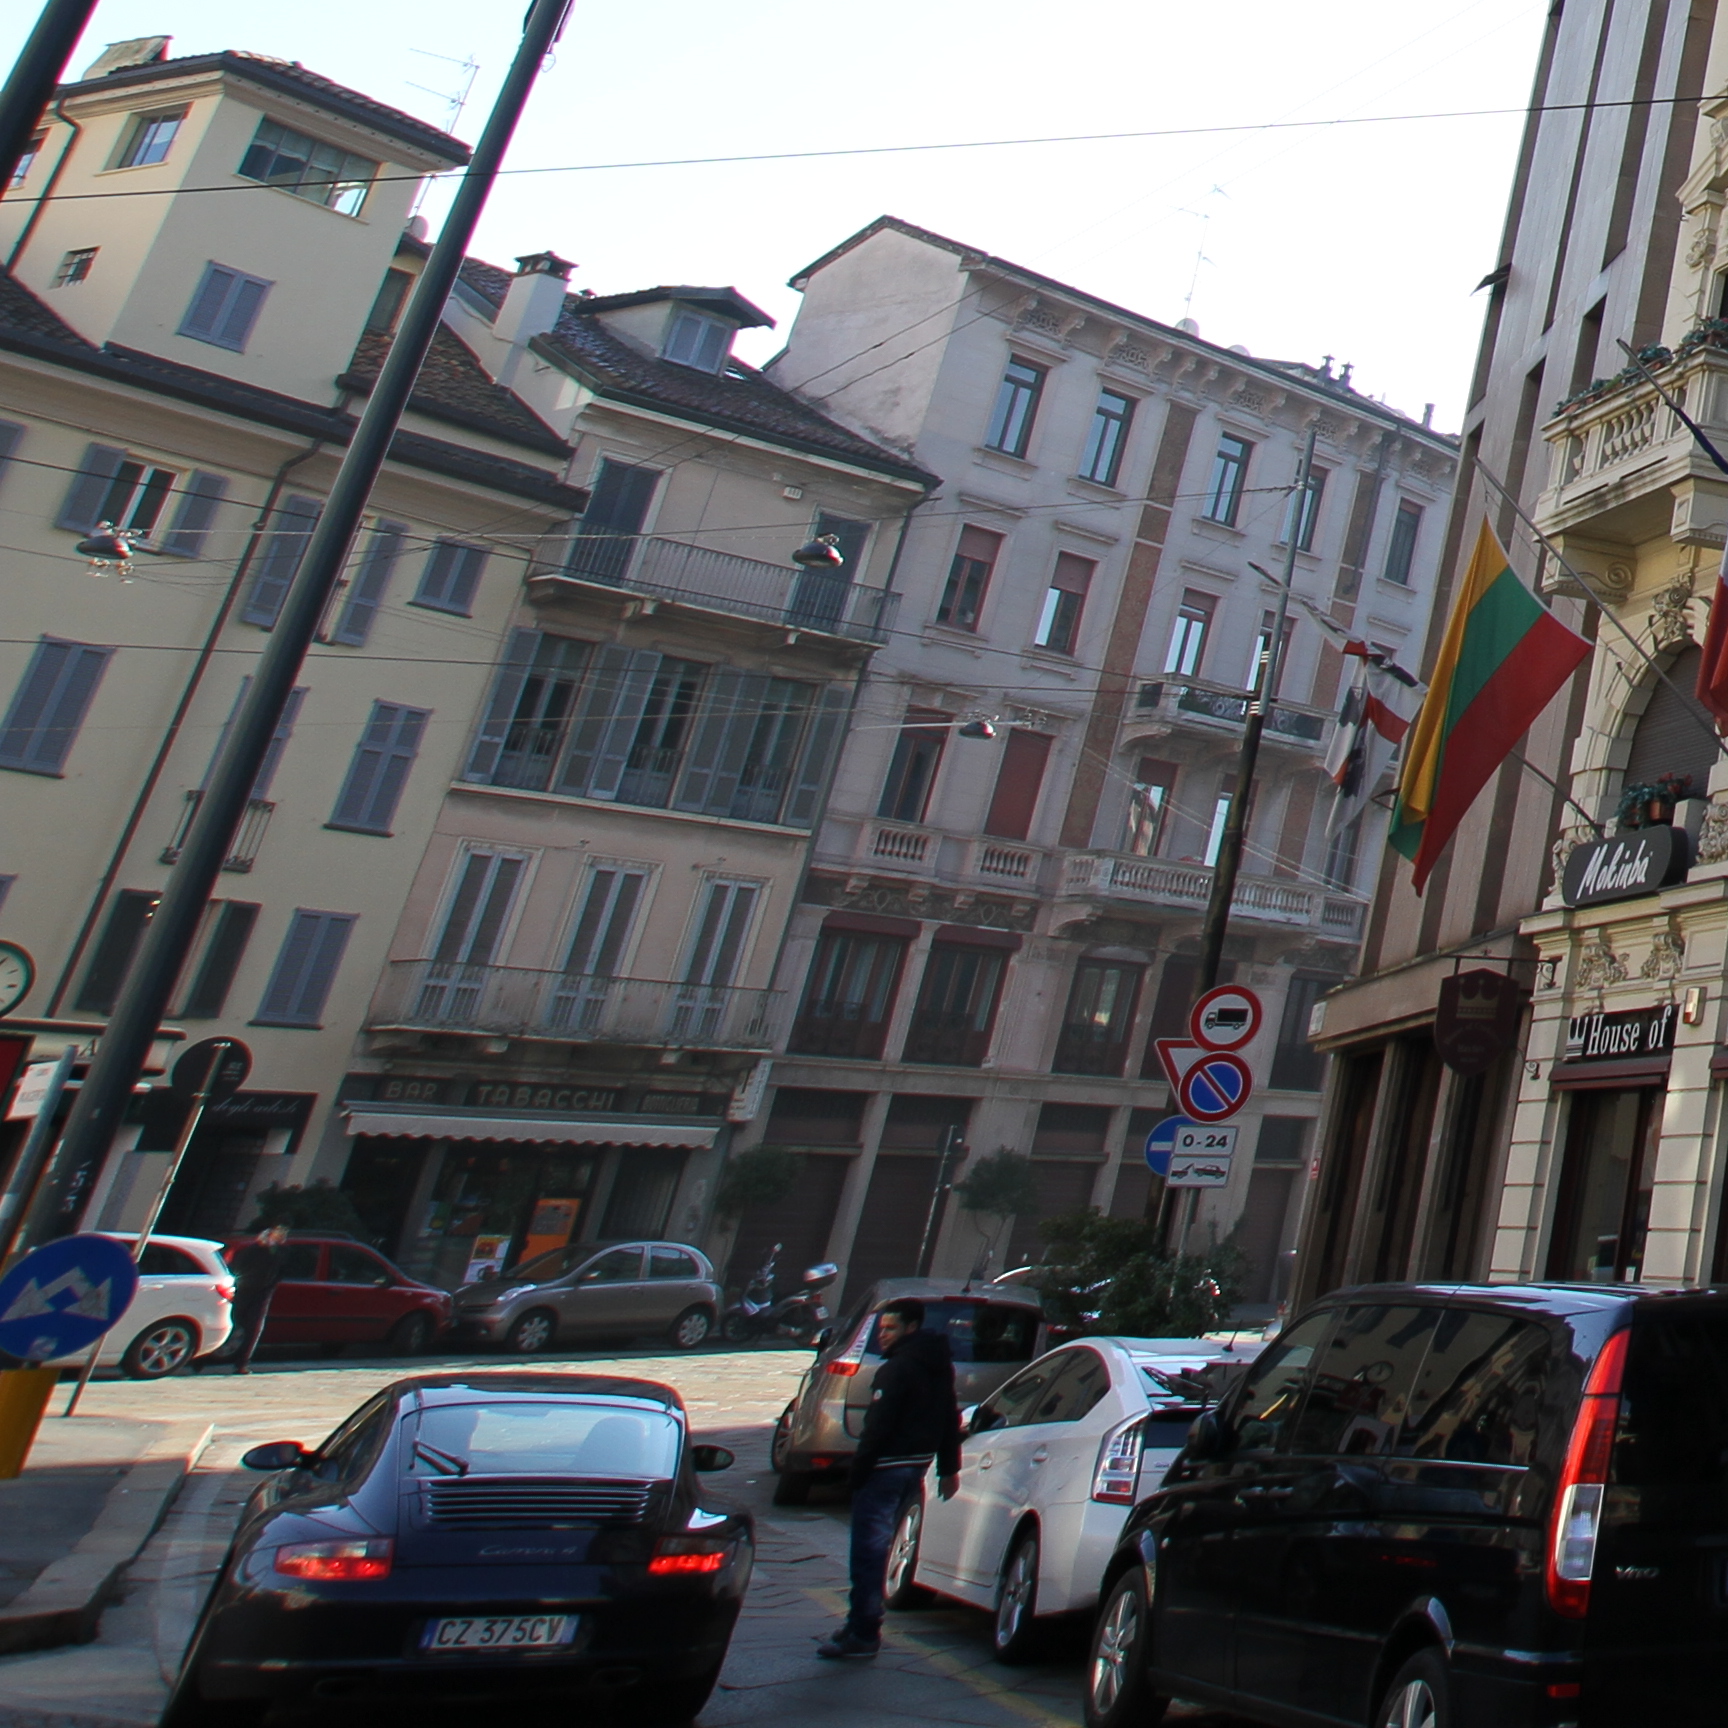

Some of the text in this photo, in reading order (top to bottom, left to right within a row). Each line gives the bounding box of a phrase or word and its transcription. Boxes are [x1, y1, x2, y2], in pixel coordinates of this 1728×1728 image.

[1575, 839, 1648, 900] Mokinba
[1586, 1013, 1640, 1056] House
[1648, 1003, 1672, 1051] of
[384, 1081, 438, 1099] BAR
[476, 1085, 617, 1110] TABACCHI
[437, 1619, 475, 1645] CZ
[480, 1617, 564, 1644] 375CV
